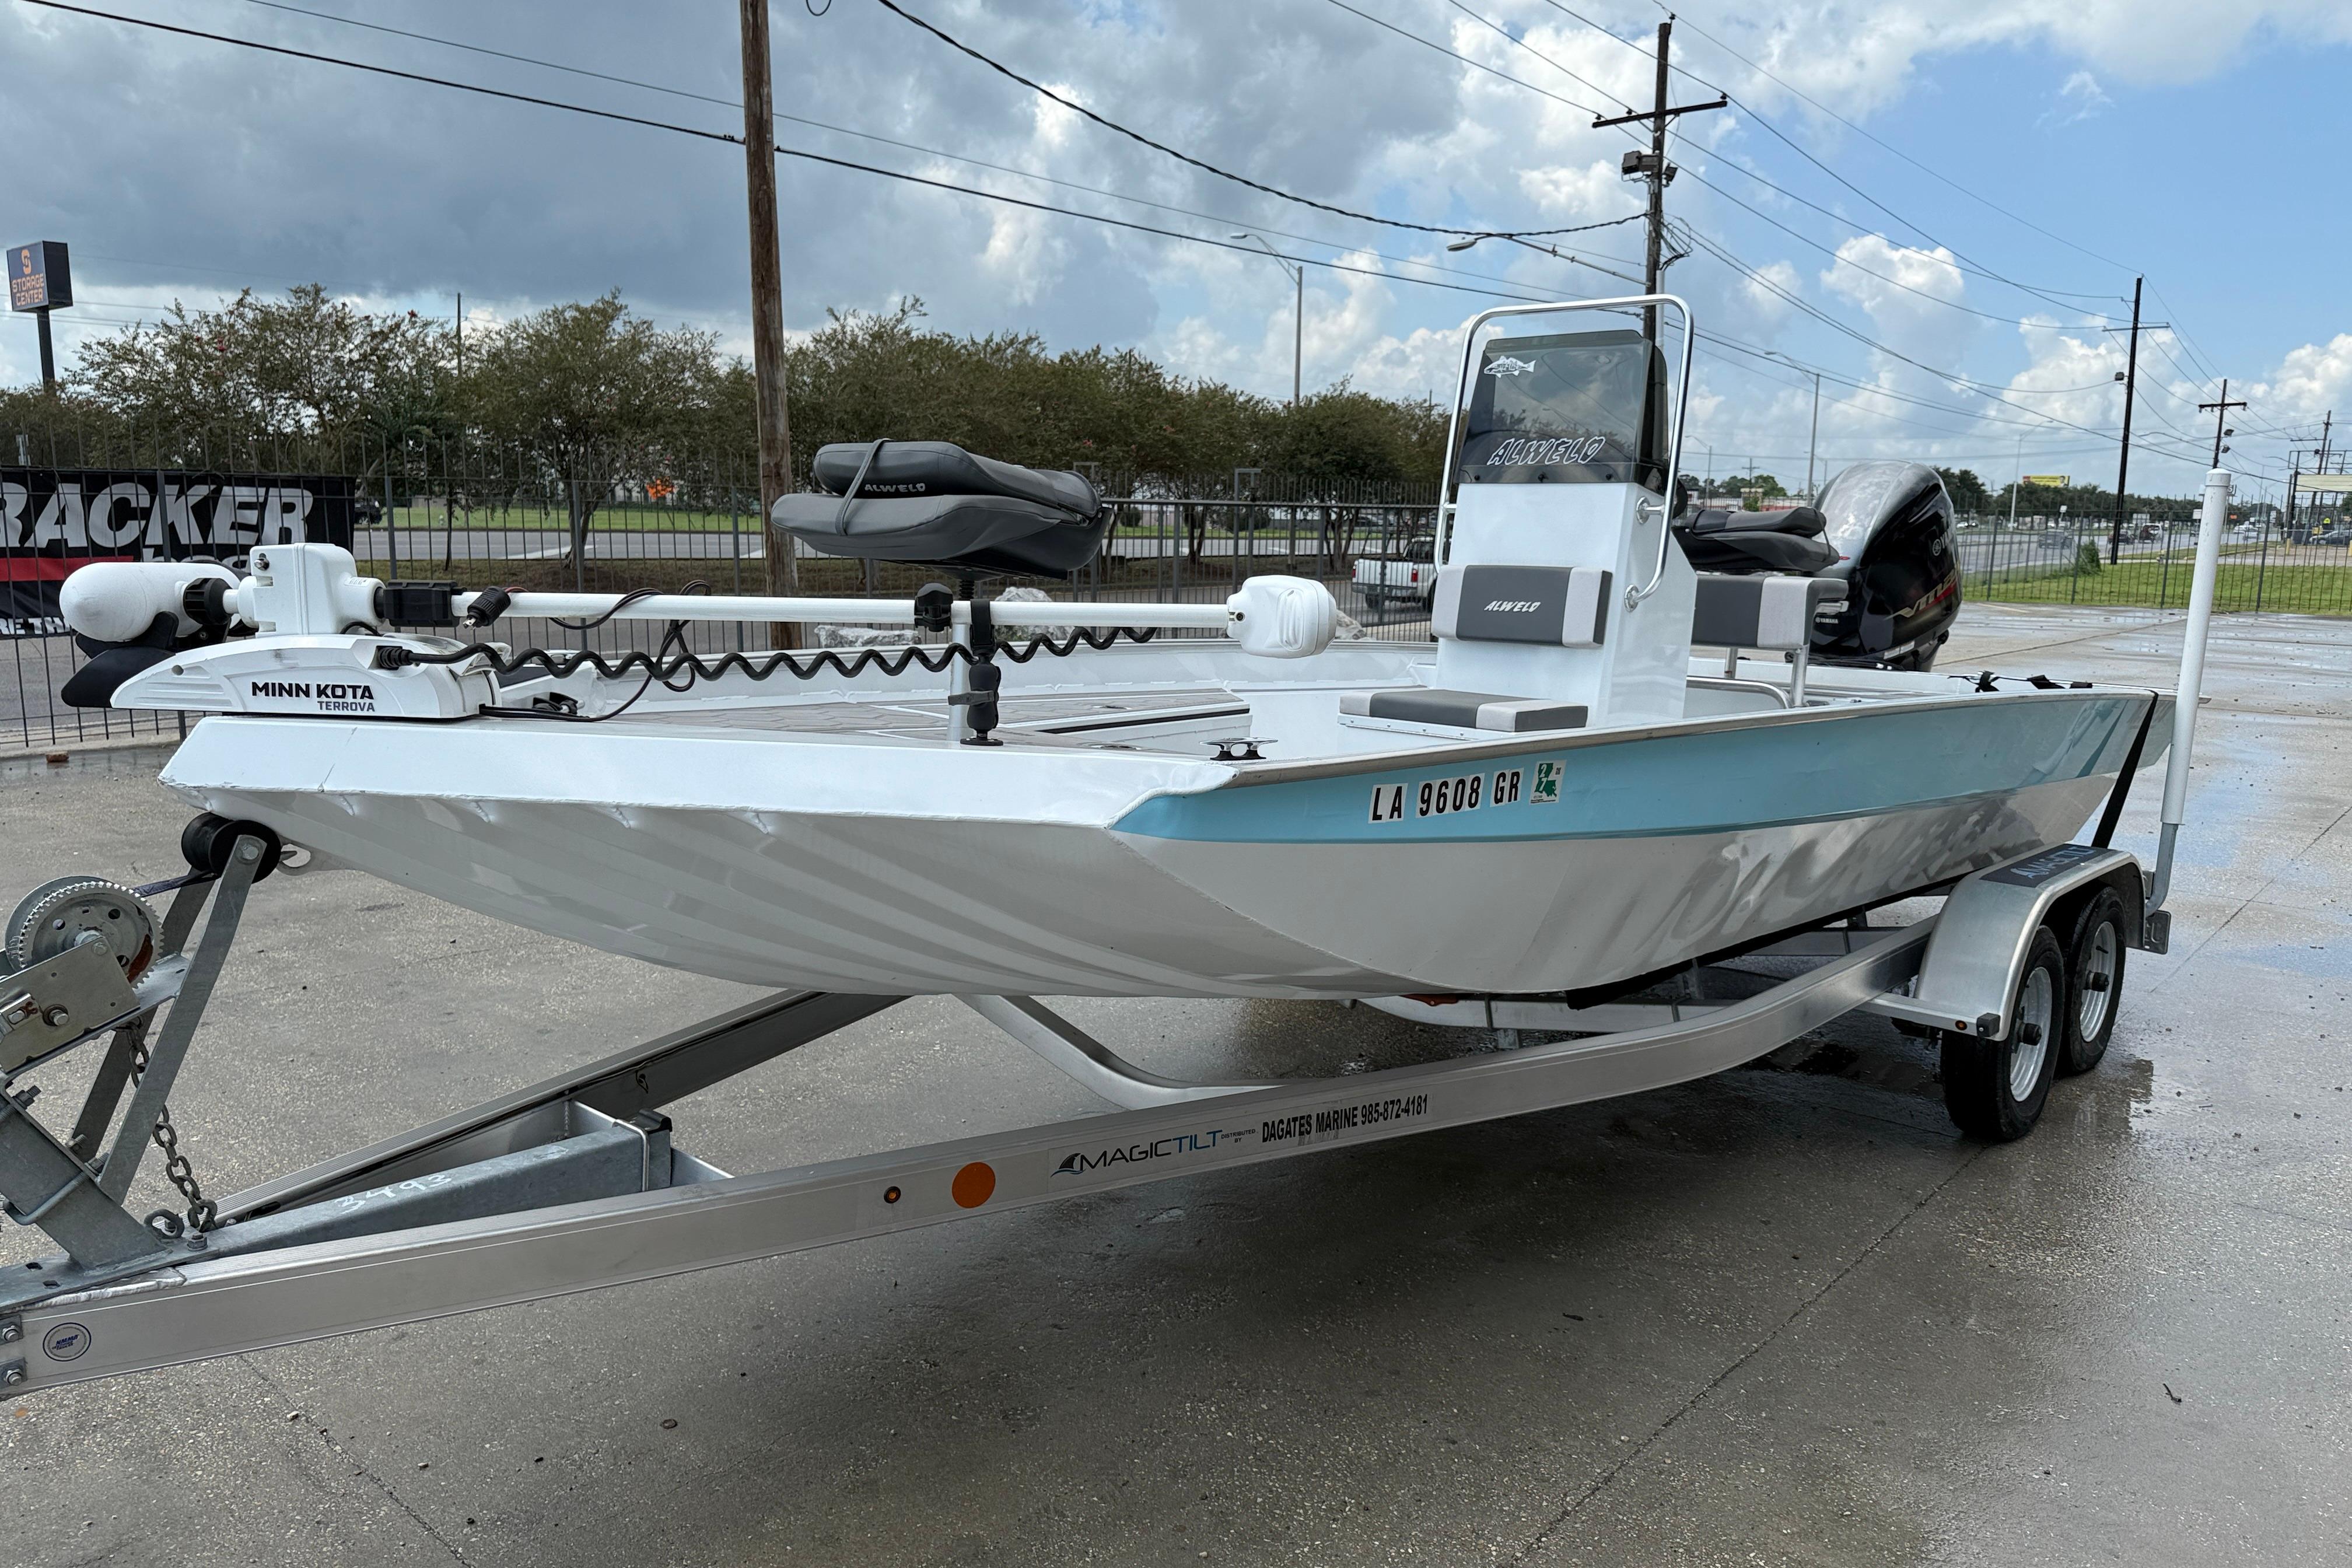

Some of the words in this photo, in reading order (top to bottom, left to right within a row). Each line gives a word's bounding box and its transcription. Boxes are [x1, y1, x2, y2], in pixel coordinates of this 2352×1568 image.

[12, 273, 44, 292] STORAGE
[16, 289, 44, 306] CENTER
[1486, 436, 1605, 466] ALWELD
[864, 483, 926, 492] ALWELD
[1484, 601, 1541, 612] ALWELD
[28, 617, 71, 634] TH
[252, 682, 310, 698] MINN
[317, 684, 374, 699] KOTA
[317, 701, 375, 712] TERROVA
[1372, 786, 1403, 821] LA
[1419, 775, 1482, 817] 9608
[1494, 771, 1521, 804] GR
[1262, 1114, 1312, 1143] DAGATES
[1315, 1106, 1359, 1133] MARINE
[1361, 1094, 1429, 1125] 985-872-4181
[1080, 1129, 1223, 1171] MAGICTILT
[1221, 1129, 1256, 1139] DISTRIBUTED
[334, 1174, 452, 1214] 3493
